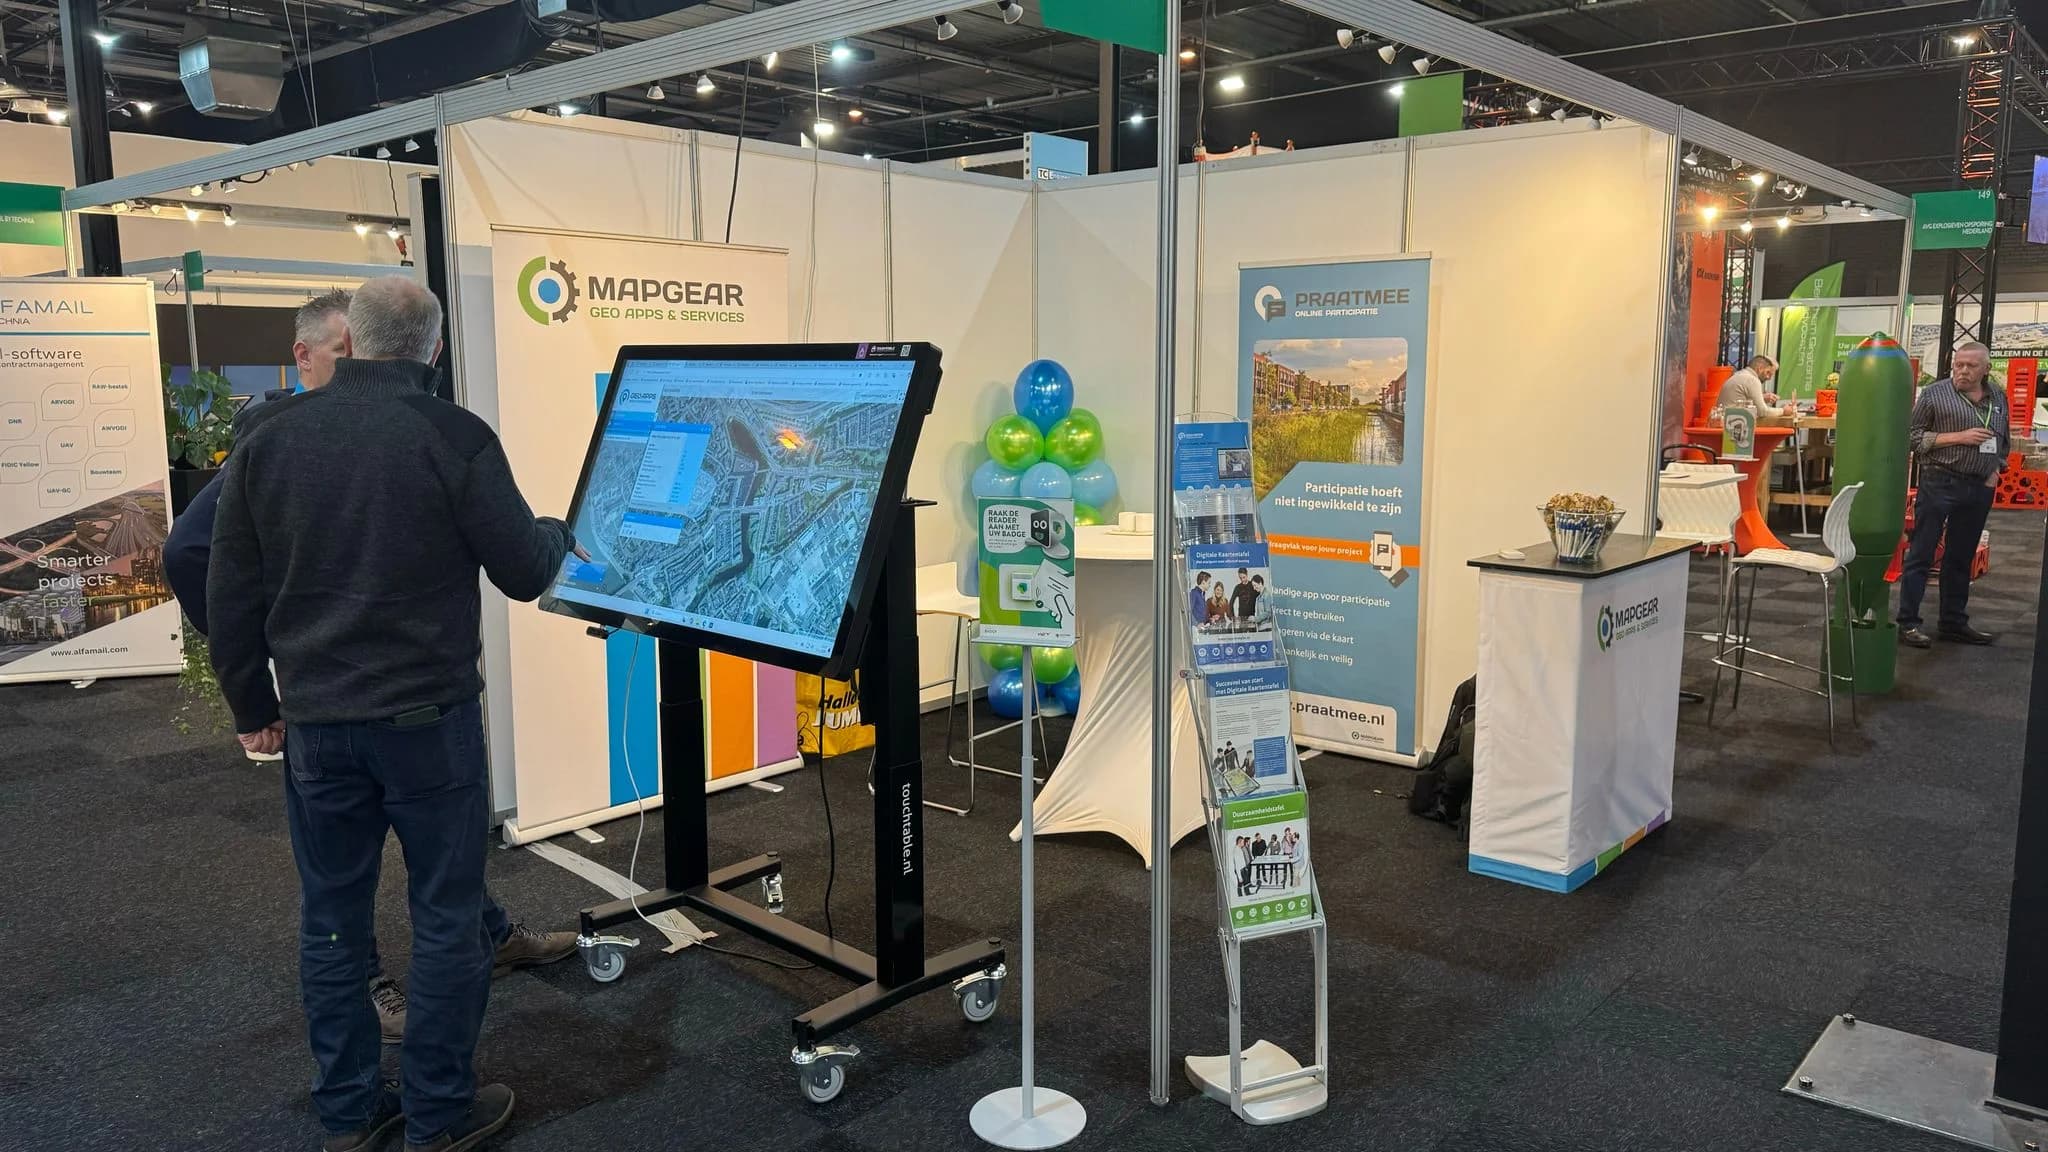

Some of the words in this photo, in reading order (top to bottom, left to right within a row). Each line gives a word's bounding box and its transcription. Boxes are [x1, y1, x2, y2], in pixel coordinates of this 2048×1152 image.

[1978, 190, 1991, 199] 149
[588, 276, 745, 306] MAPGEAR
[1295, 288, 1410, 307] PRAATMEE
[0, 299, 94, 314] FAMAIL
[590, 306, 620, 319] GEO
[624, 308, 664, 320] APPS
[667, 310, 677, 320] &
[681, 310, 745, 323] SERVICES
[1295, 309, 1323, 318] ONLINE
[1325, 307, 1379, 317] PARTICIPATIE
[0, 361, 84, 369] ontractmanagement
[1305, 482, 1369, 497] Participatie
[1371, 486, 1403, 498] hoeft
[1275, 496, 1295, 507] niet
[1297, 497, 1365, 513] ingewikkeld
[1367, 503, 1378, 513] te
[1380, 503, 1402, 516] zijn
[1301, 544, 1317, 552] voor
[1318, 544, 1336, 553] jouw
[1337, 547, 1363, 556] project
[37, 554, 111, 568] Smarter
[39, 573, 114, 590] projects
[42, 595, 95, 608] faster
[1303, 590, 1319, 600] app
[1320, 593, 1340, 601] voor
[1341, 595, 1391, 608] participatie
[1293, 608, 1302, 617] te
[1303, 610, 1345, 622] gebruiken
[1615, 597, 1659, 628] MAPGEAR
[1280, 628, 1304, 637] geren
[1306, 630, 1318, 639] via
[1320, 631, 1331, 640] de
[1332, 633, 1354, 644] kaart
[50, 646, 129, 657] www.alfamail.com
[1285, 648, 1317, 660] ankelijk
[1330, 655, 1353, 666] veilig
[818, 690, 857, 709] Hallo
[812, 706, 861, 729] JUM
[1290, 702, 1385, 726] .praatmee.nl
[902, 783, 914, 876] touchtable.nl
